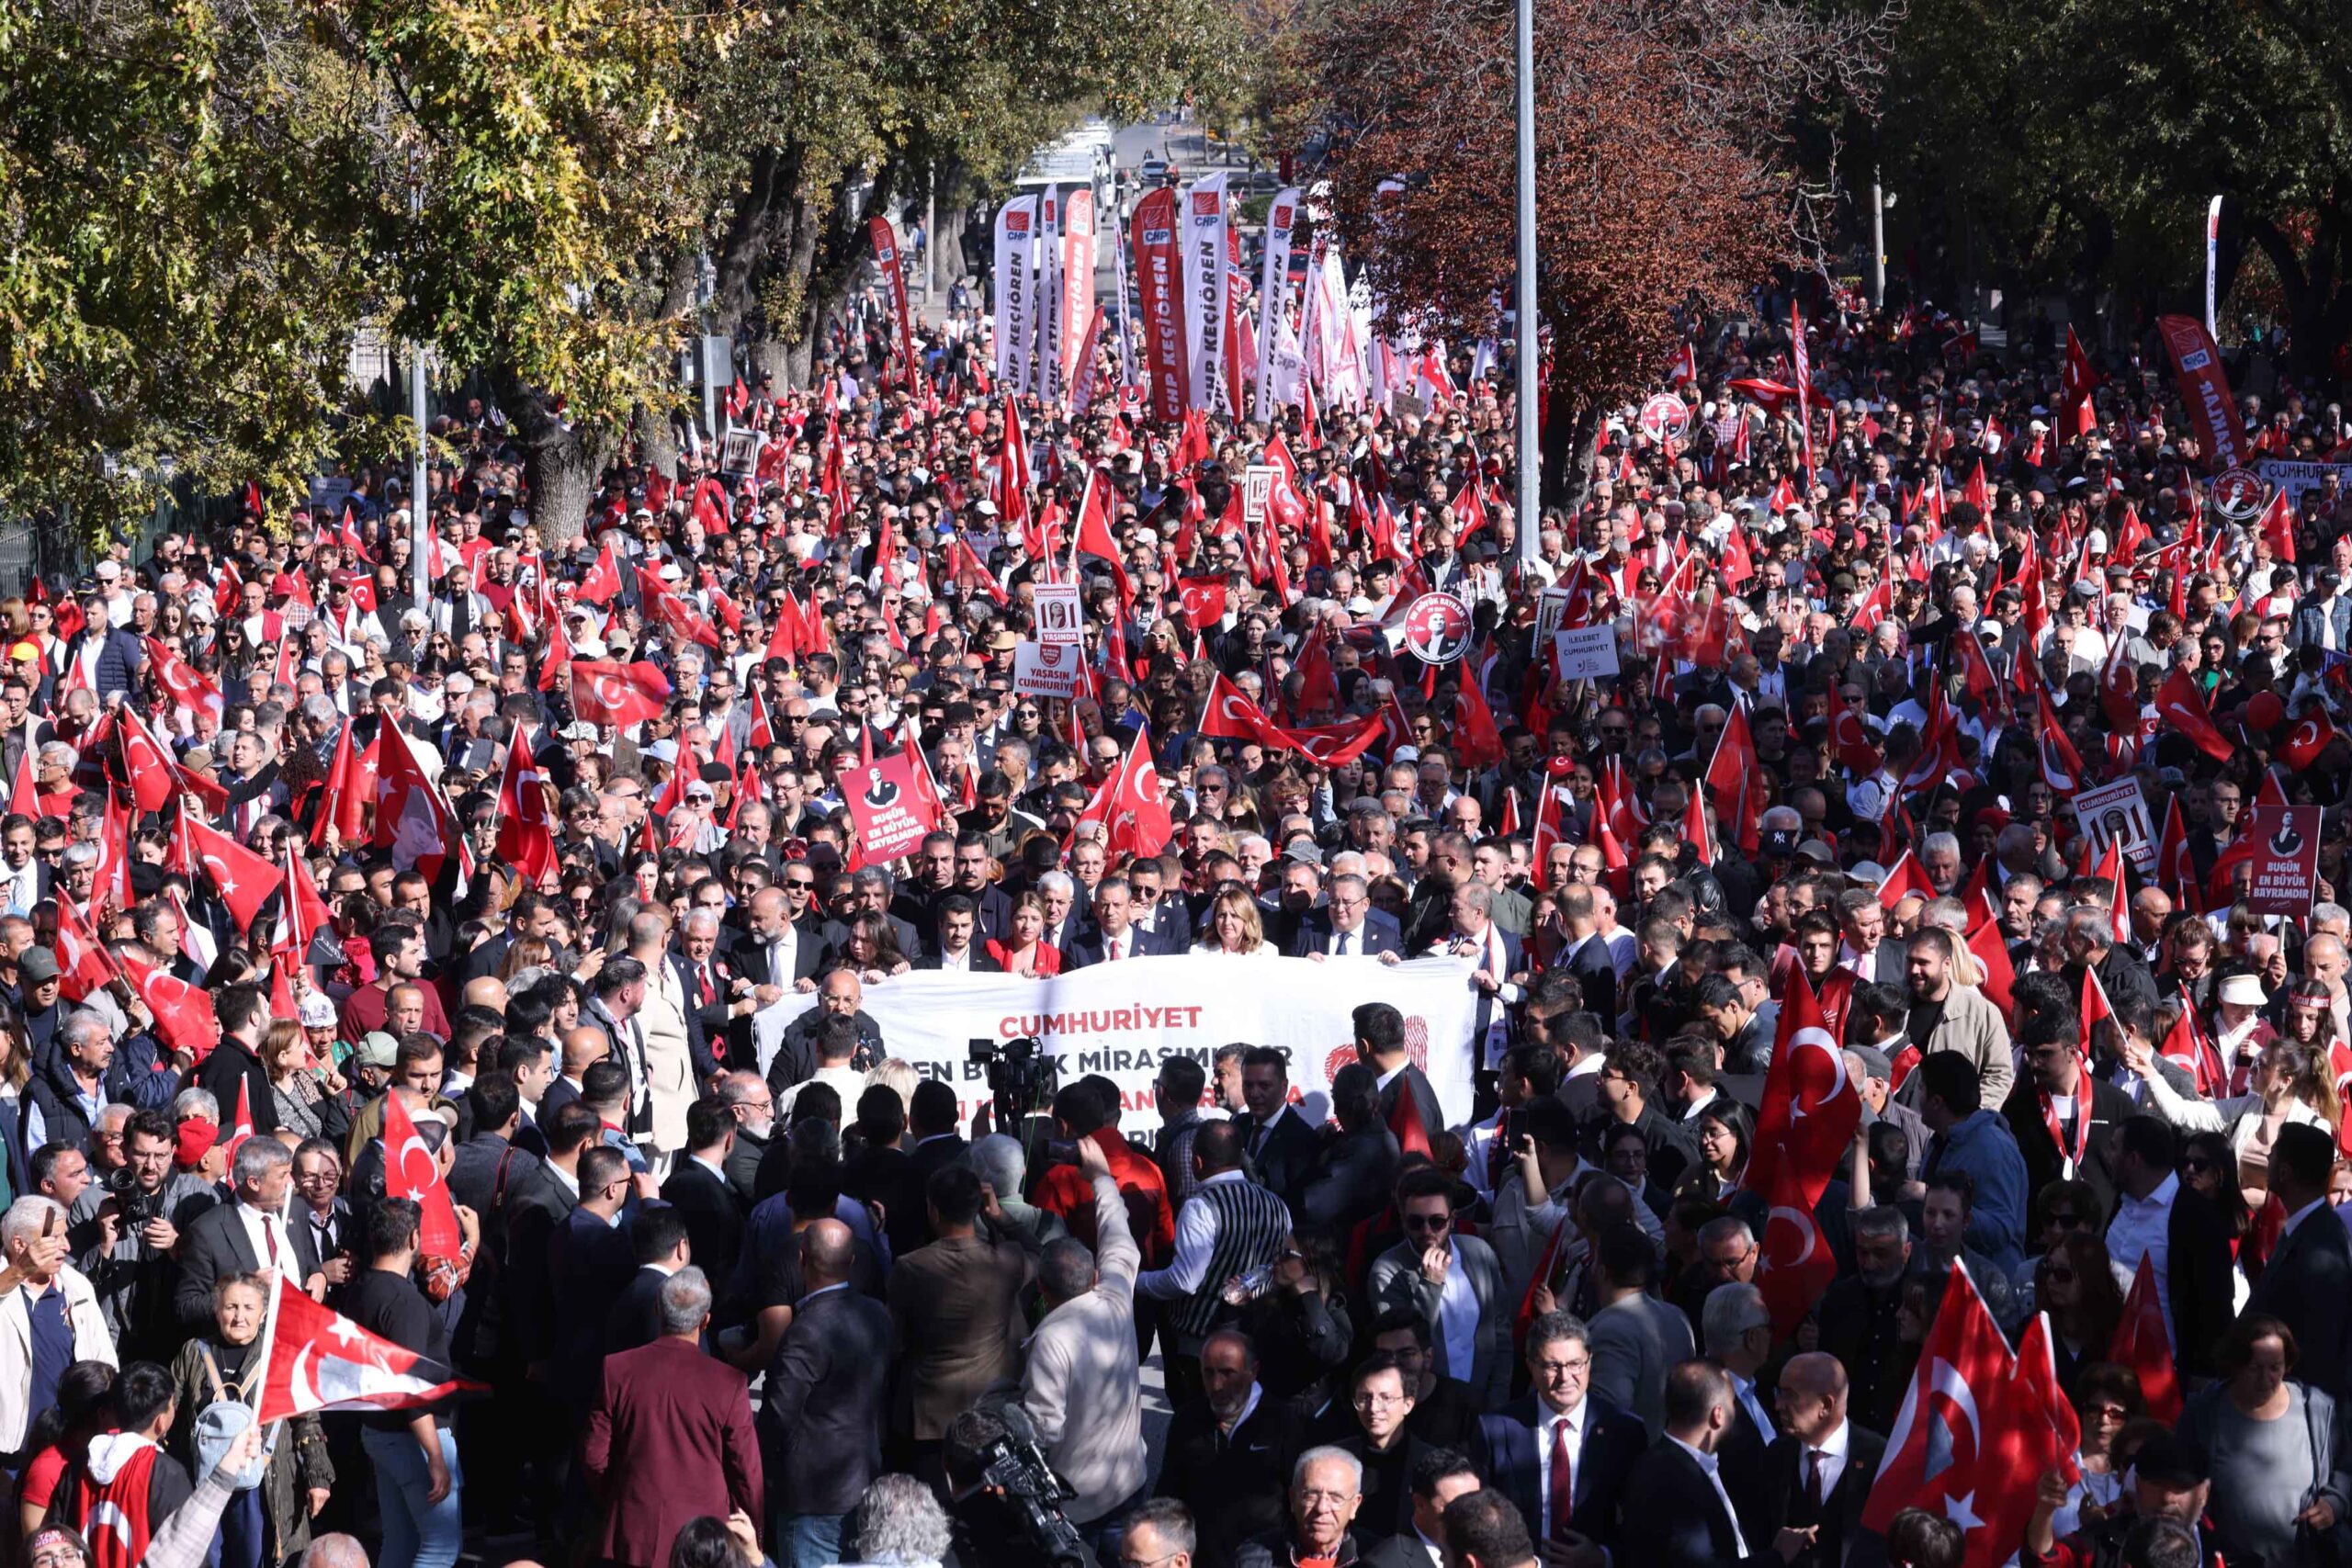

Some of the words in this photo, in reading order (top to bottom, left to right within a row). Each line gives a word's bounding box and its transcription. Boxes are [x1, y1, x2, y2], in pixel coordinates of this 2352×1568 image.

[1194, 216, 1218, 227] CHP
[1007, 231, 1028, 242] CHP
[1145, 231, 1169, 243] CHP
[1274, 229, 1289, 240] CHP
[1006, 252, 1024, 347] KEÇİÖREN
[1198, 242, 1220, 352] KEÇİÖREN
[1151, 255, 1178, 367] KEÇİÖREN
[1008, 353, 1020, 389] CHP
[1164, 377, 1180, 416] CHP
[1044, 633, 1078, 642] YAŞINDA
[1567, 633, 1600, 644] İLELEBET
[1563, 644, 1609, 656] CUMHURİYET
[1031, 668, 1070, 680] YAŞASIN
[1018, 677, 1076, 692] CUMHURİYE
[2079, 785, 2135, 810] CUMHURİYET
[871, 807, 907, 826] BUGÜN
[867, 829, 883, 840] EN
[881, 815, 918, 835] BÜYÜK
[866, 825, 926, 852] BAYRAMDIR
[2267, 859, 2301, 873] BUGÜN
[2258, 875, 2272, 886] EN
[2273, 873, 2306, 886] BÜYÜK
[2253, 887, 2310, 899] BAYRAMDIR
[1000, 1002, 1203, 1038] CUMHURİYET
[912, 1060, 954, 1082] EN
